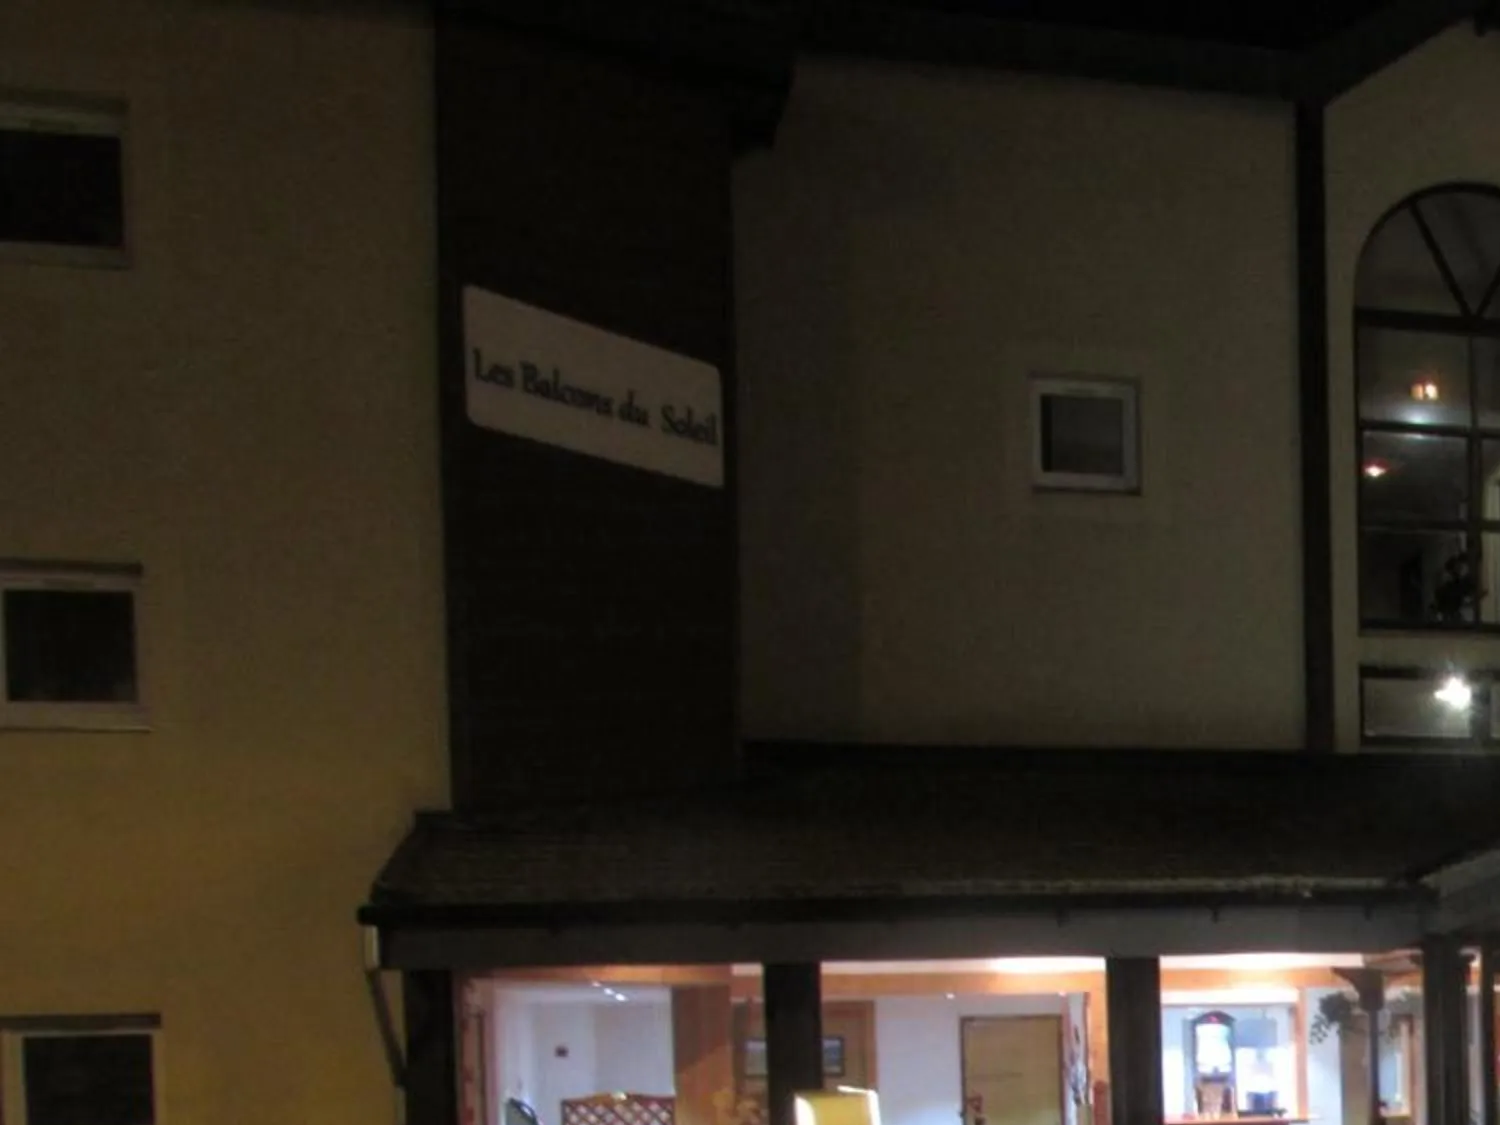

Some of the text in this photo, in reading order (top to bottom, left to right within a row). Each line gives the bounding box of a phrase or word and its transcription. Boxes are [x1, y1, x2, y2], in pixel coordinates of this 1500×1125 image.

[472, 347, 717, 446] Les Balcons du Soleil
